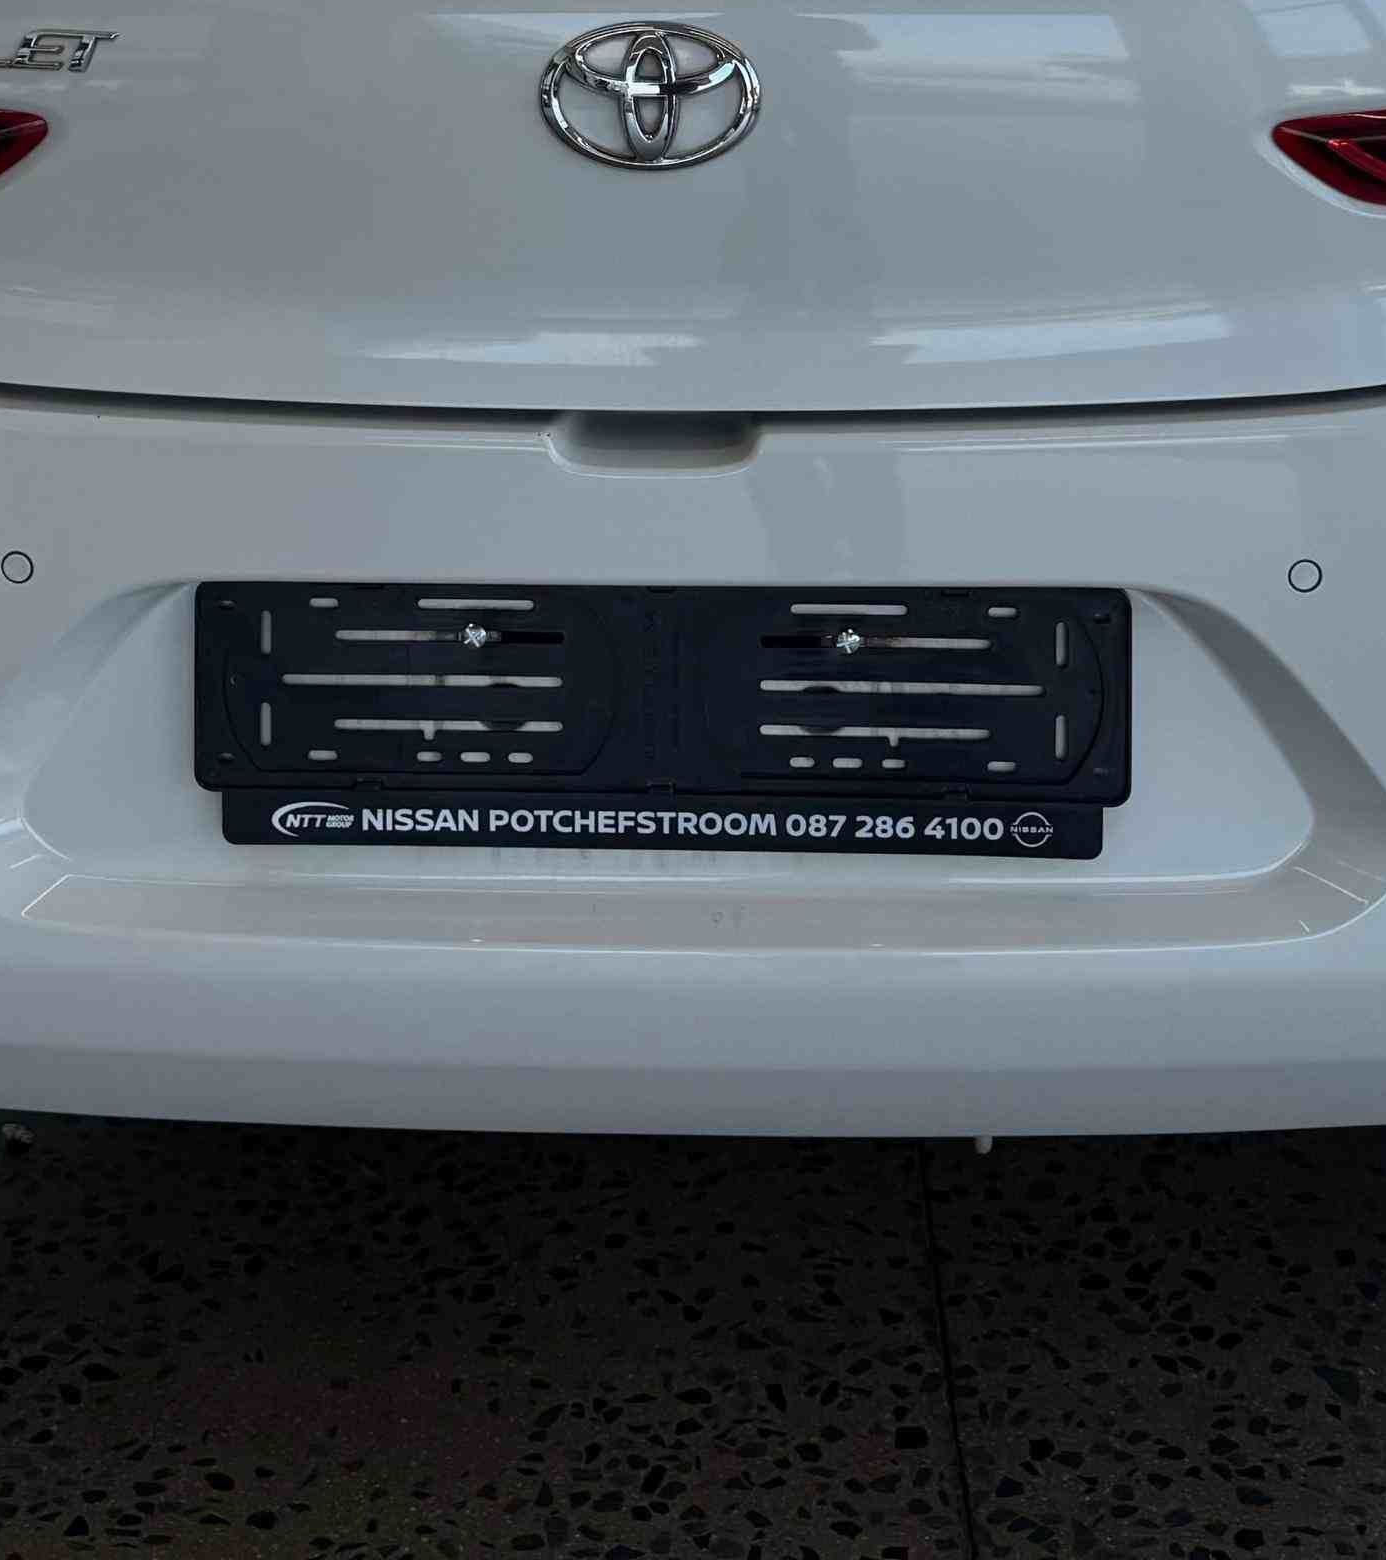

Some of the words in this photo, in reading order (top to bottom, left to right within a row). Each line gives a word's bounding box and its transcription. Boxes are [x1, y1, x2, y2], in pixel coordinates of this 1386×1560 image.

[286, 814, 327, 828] NTT
[362, 808, 479, 832] NISSAN
[489, 809, 777, 836] POTCHEFSTROOM
[785, 813, 847, 838] 087
[855, 815, 915, 839] 286
[924, 816, 1004, 841] 4100
